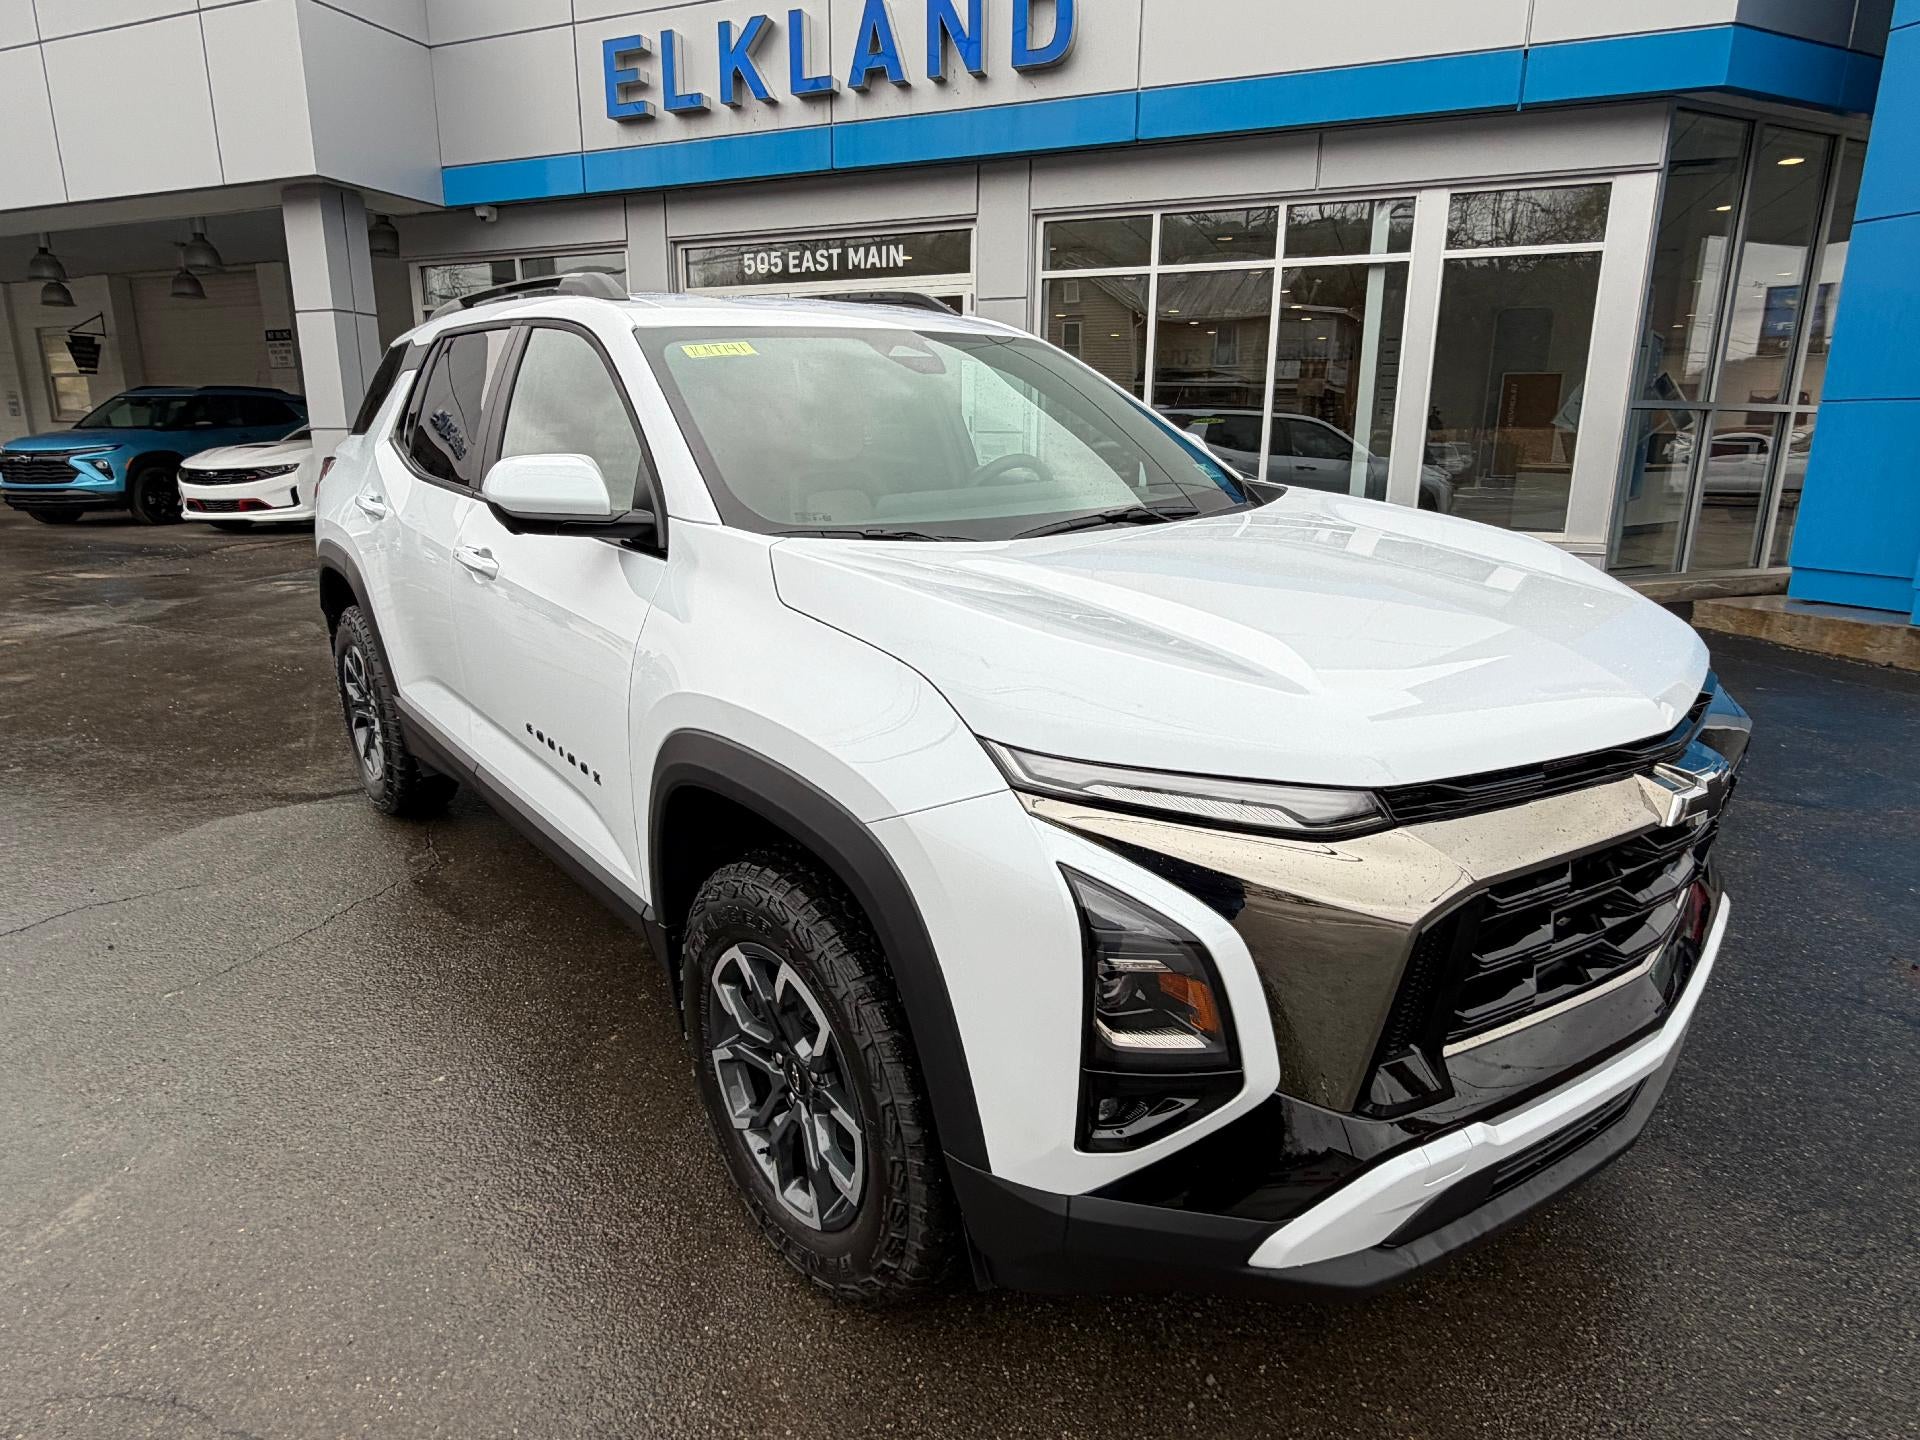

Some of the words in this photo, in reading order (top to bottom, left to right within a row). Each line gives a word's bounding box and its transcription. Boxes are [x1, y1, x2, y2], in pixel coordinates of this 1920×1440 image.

[602, 0, 1079, 122] ELKLAND
[743, 251, 783, 275] 505
[788, 247, 842, 273] EAST
[847, 244, 904, 269] MAIN
